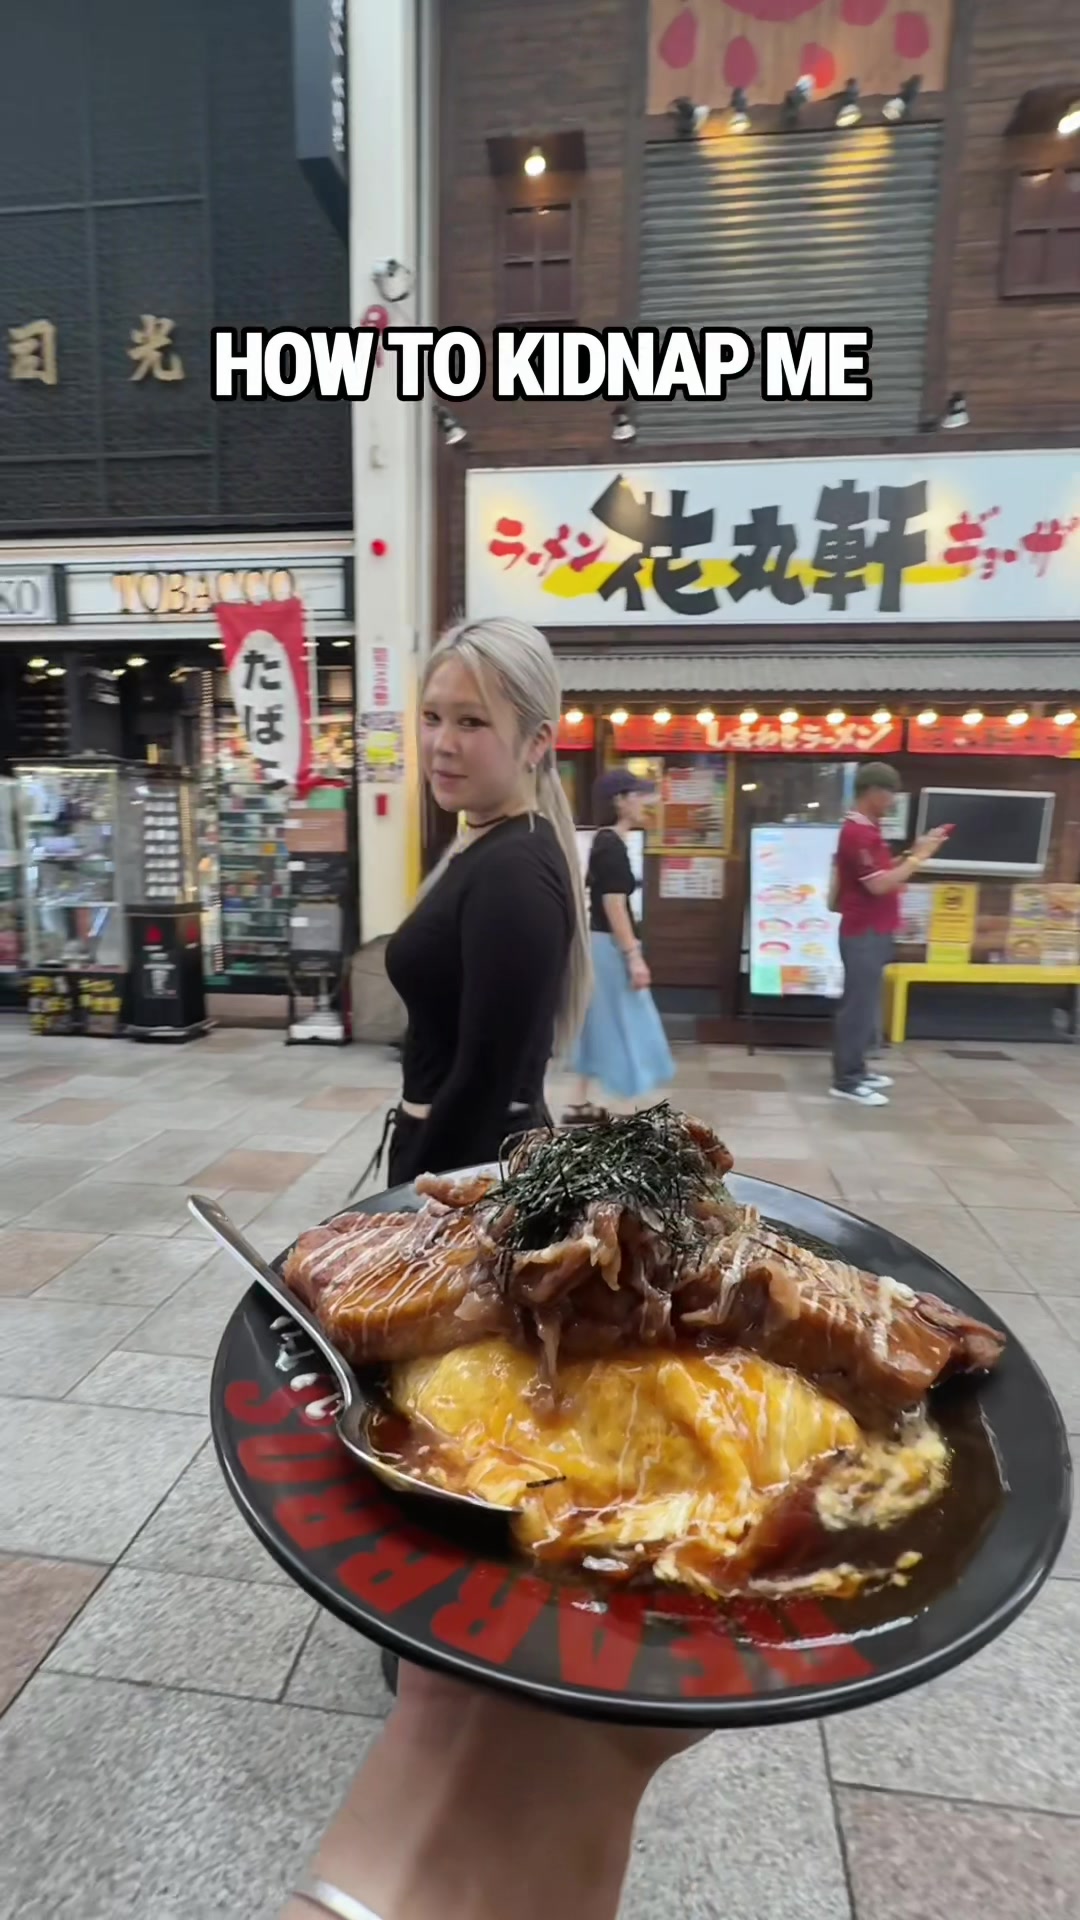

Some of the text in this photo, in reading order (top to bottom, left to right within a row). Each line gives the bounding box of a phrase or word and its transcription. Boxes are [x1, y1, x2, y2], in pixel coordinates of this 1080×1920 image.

[111, 568, 295, 614] TOBACCO
[488, 516, 606, 577] ラーメン
[590, 473, 928, 616] 花丸軒
[243, 649, 288, 791] たばこ
